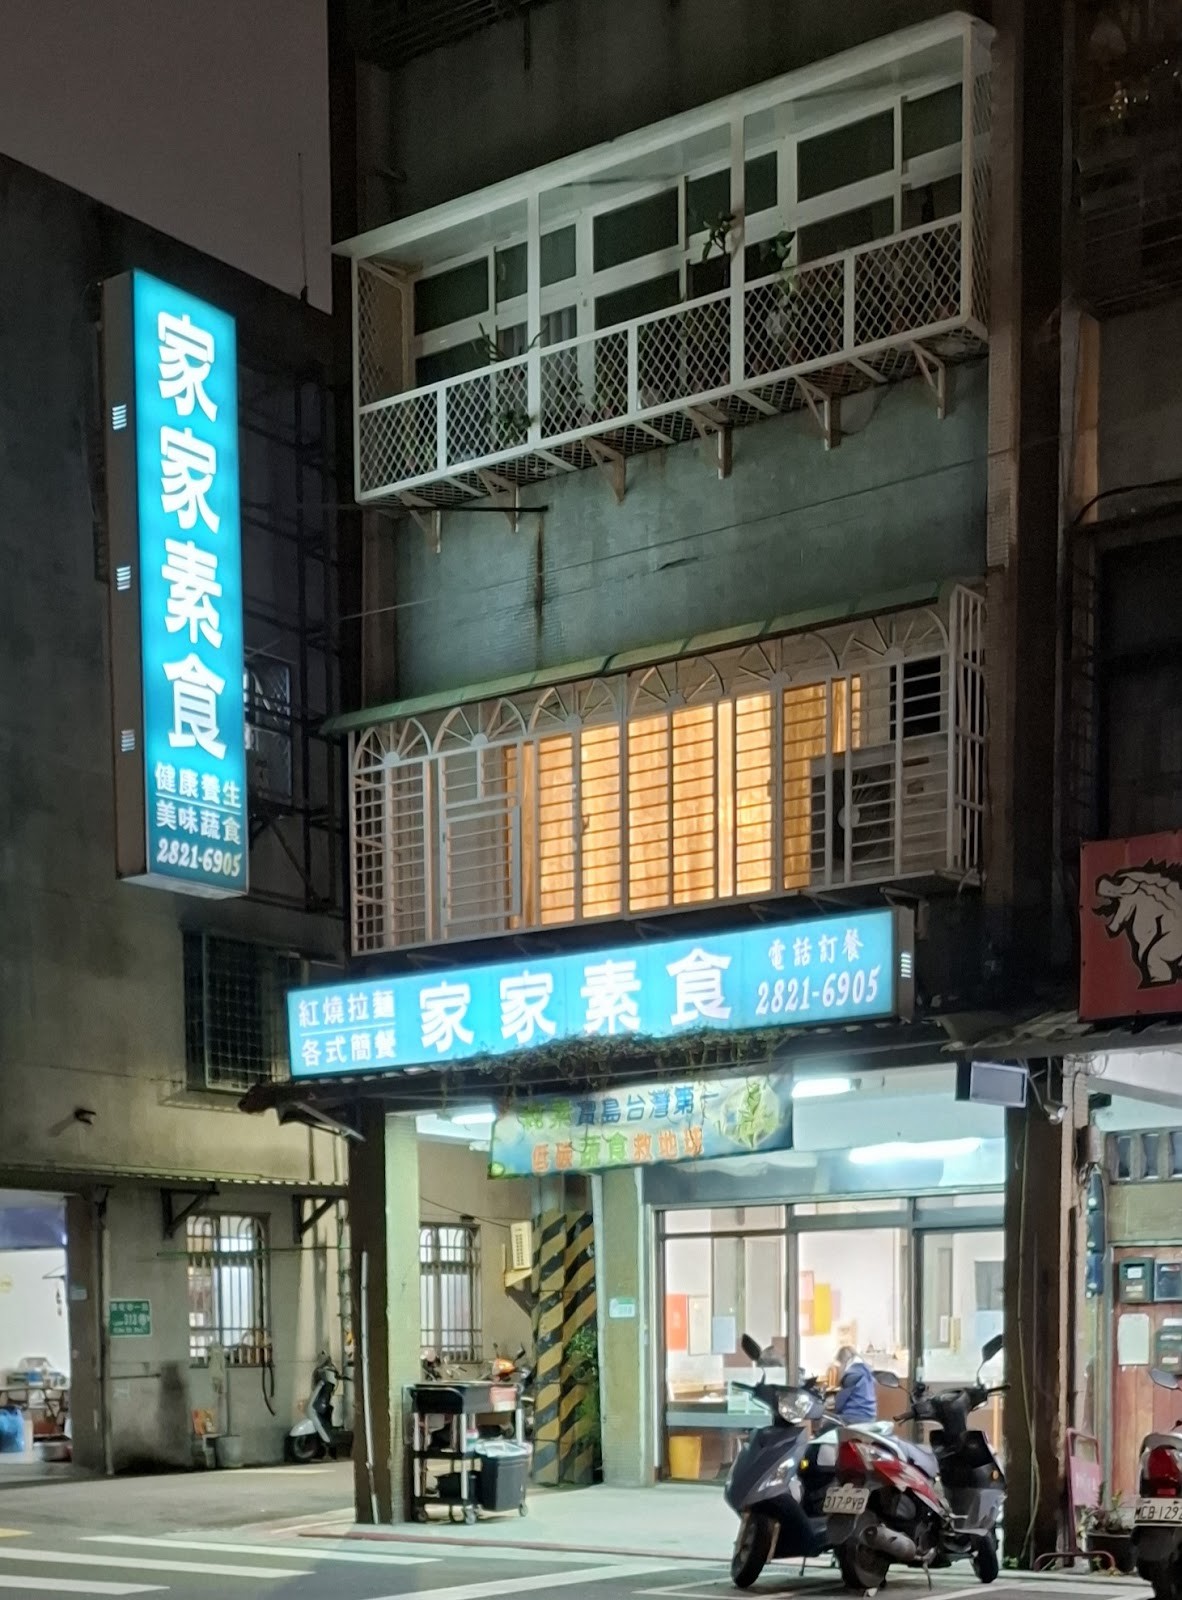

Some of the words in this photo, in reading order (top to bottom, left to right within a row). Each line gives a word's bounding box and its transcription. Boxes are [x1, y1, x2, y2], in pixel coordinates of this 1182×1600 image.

[157, 313, 226, 760] 家家素食
[155, 761, 242, 808] 健康養生
[156, 799, 241, 845] 美味蔬食
[157, 838, 242, 877] 2821-6905
[768, 928, 864, 971] 電話訂餐
[420, 948, 732, 1053] 家家素食
[755, 964, 881, 1015] 2821-6905
[302, 1029, 397, 1067] 各式簡餐
